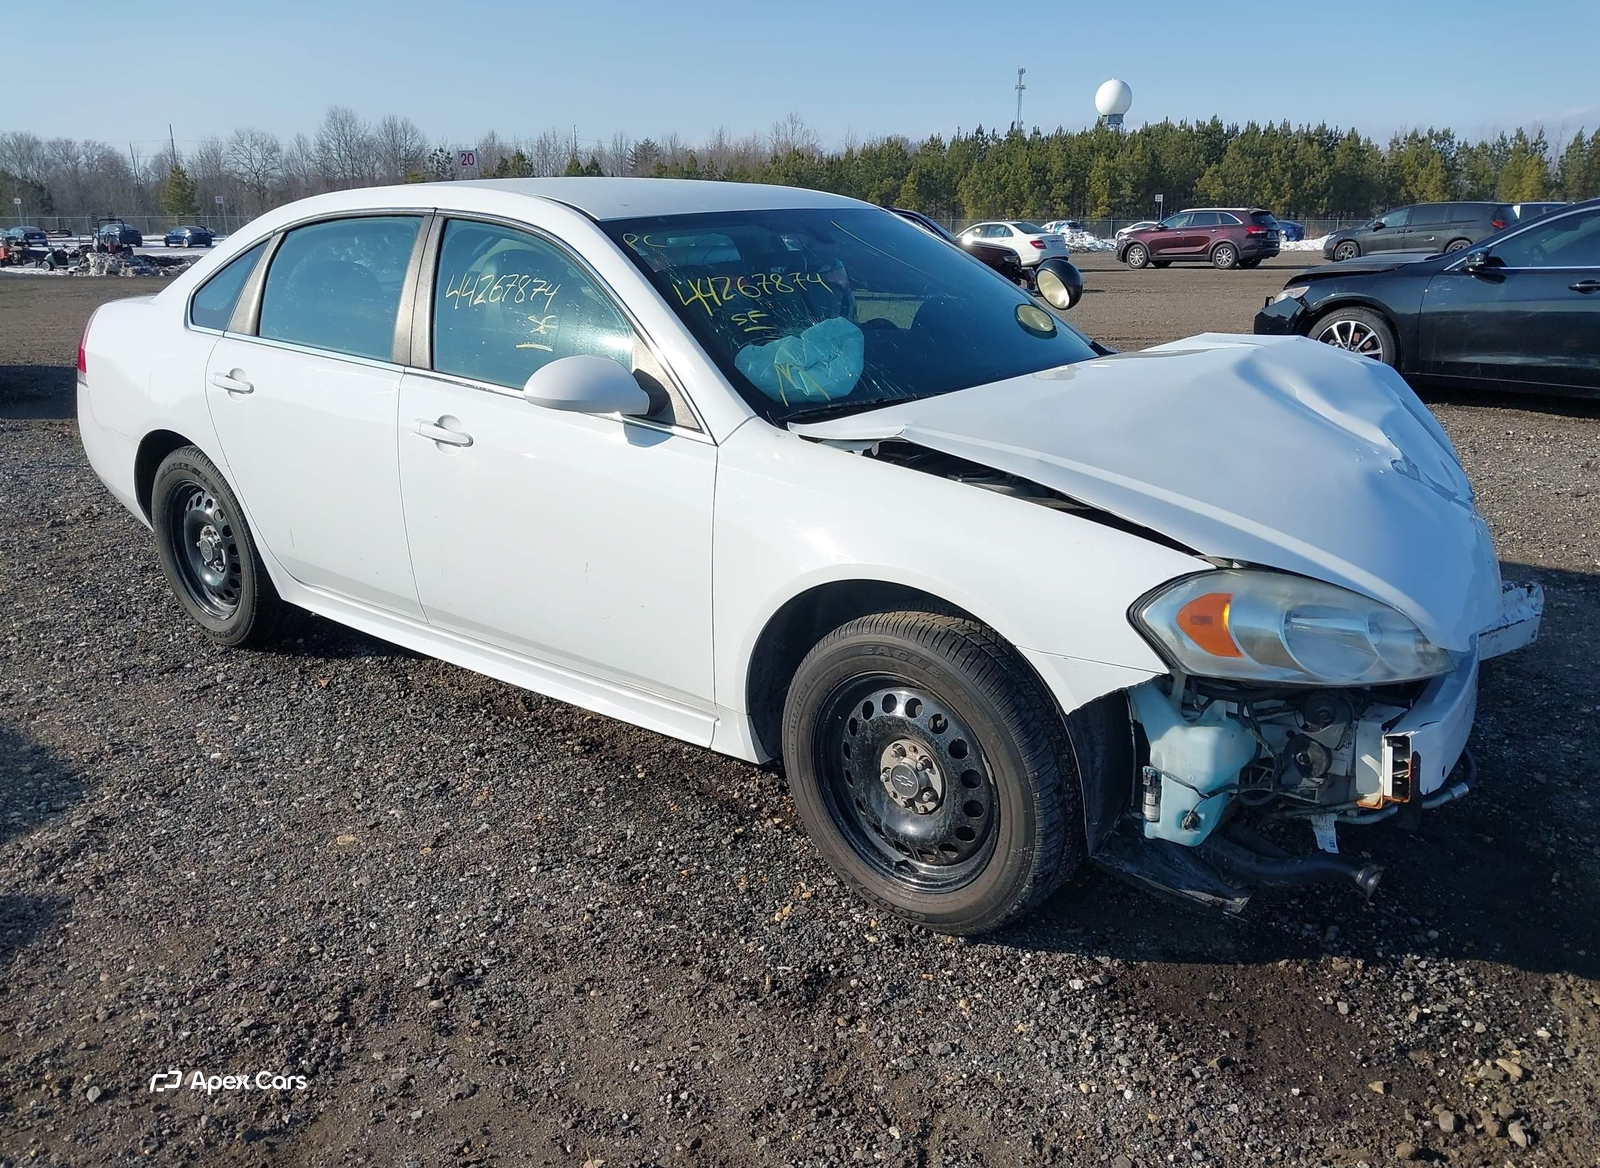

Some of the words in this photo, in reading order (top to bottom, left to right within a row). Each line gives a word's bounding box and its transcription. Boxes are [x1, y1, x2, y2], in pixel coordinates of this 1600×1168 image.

[460, 152, 475, 166] 20
[445, 272, 561, 311] 44267874
[672, 272, 834, 317] 44267874
[859, 645, 945, 679] EAGLE
